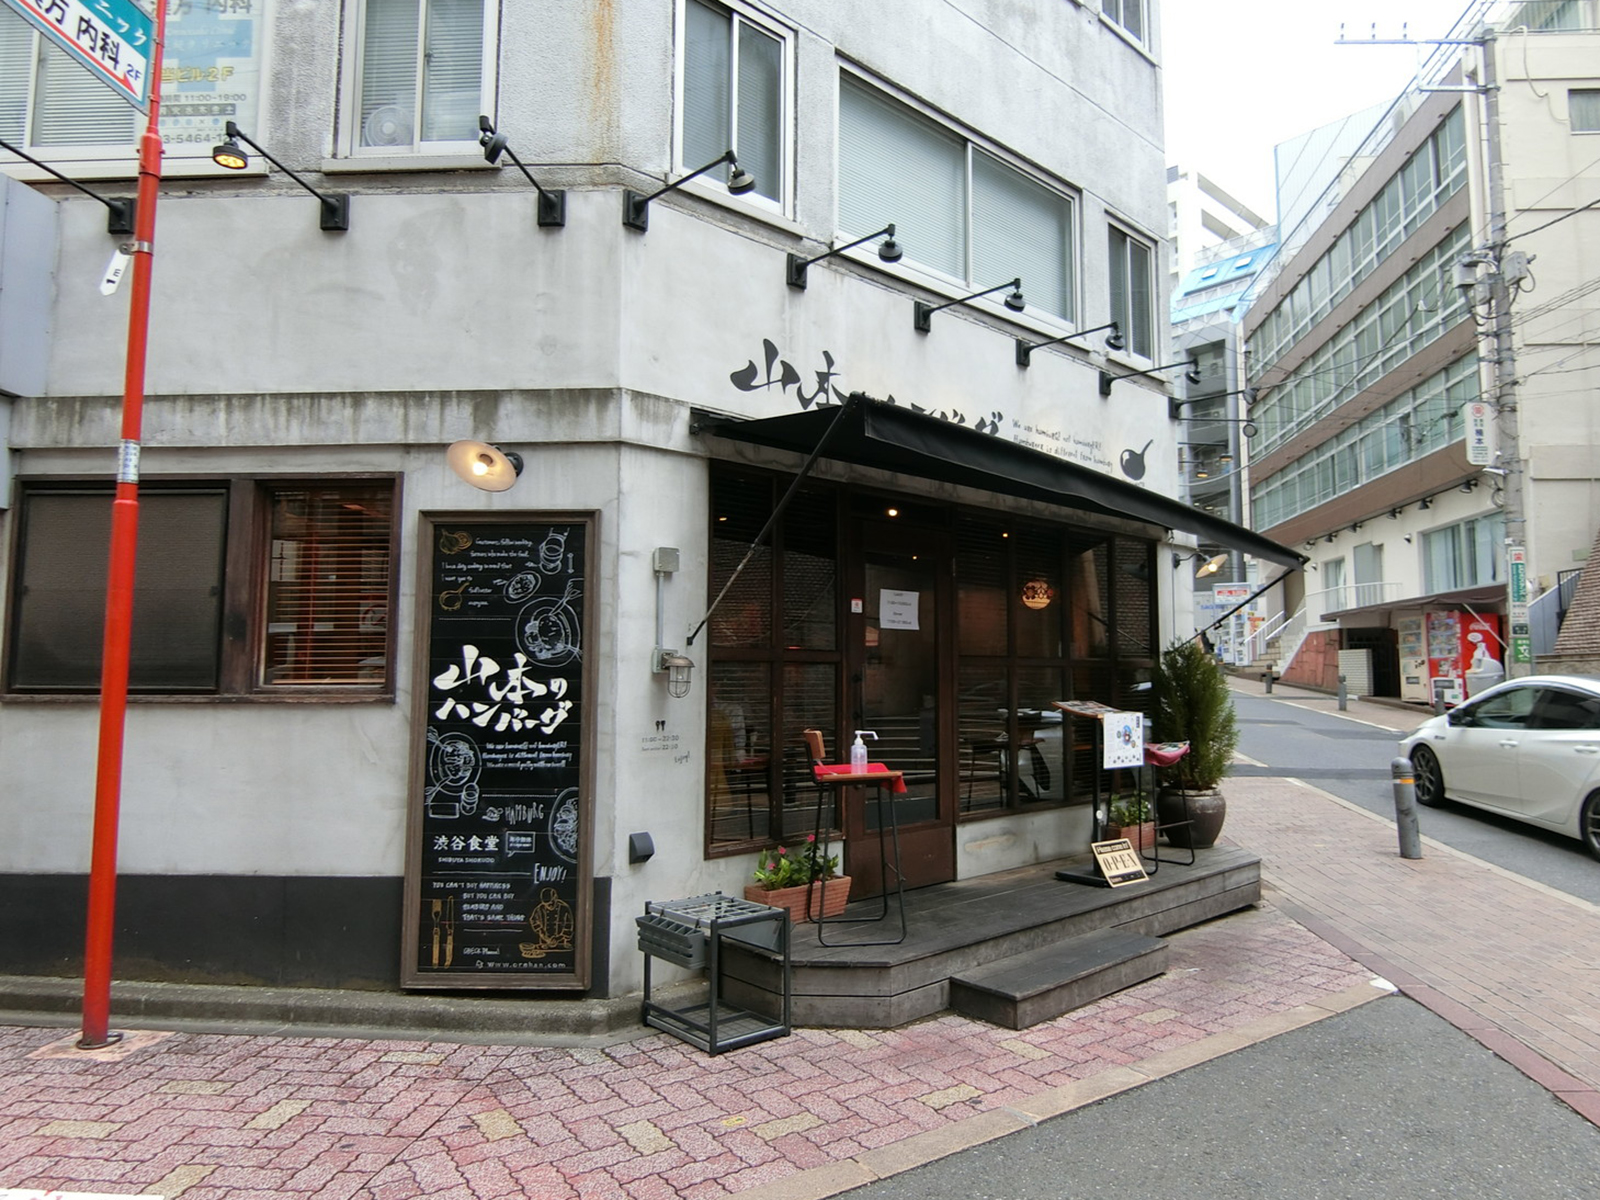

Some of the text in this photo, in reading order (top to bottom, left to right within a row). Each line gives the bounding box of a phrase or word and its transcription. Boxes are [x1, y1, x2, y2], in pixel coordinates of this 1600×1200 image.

[36, 0, 121, 71] 方 内科
[125, 63, 143, 81] 2F
[1517, 645, 1531, 658] 文
[435, 697, 573, 735] ハンバーグ
[504, 801, 544, 825] HAMBURG
[433, 834, 500, 851] 渋谷食堂
[534, 863, 568, 884] ENJOY!
